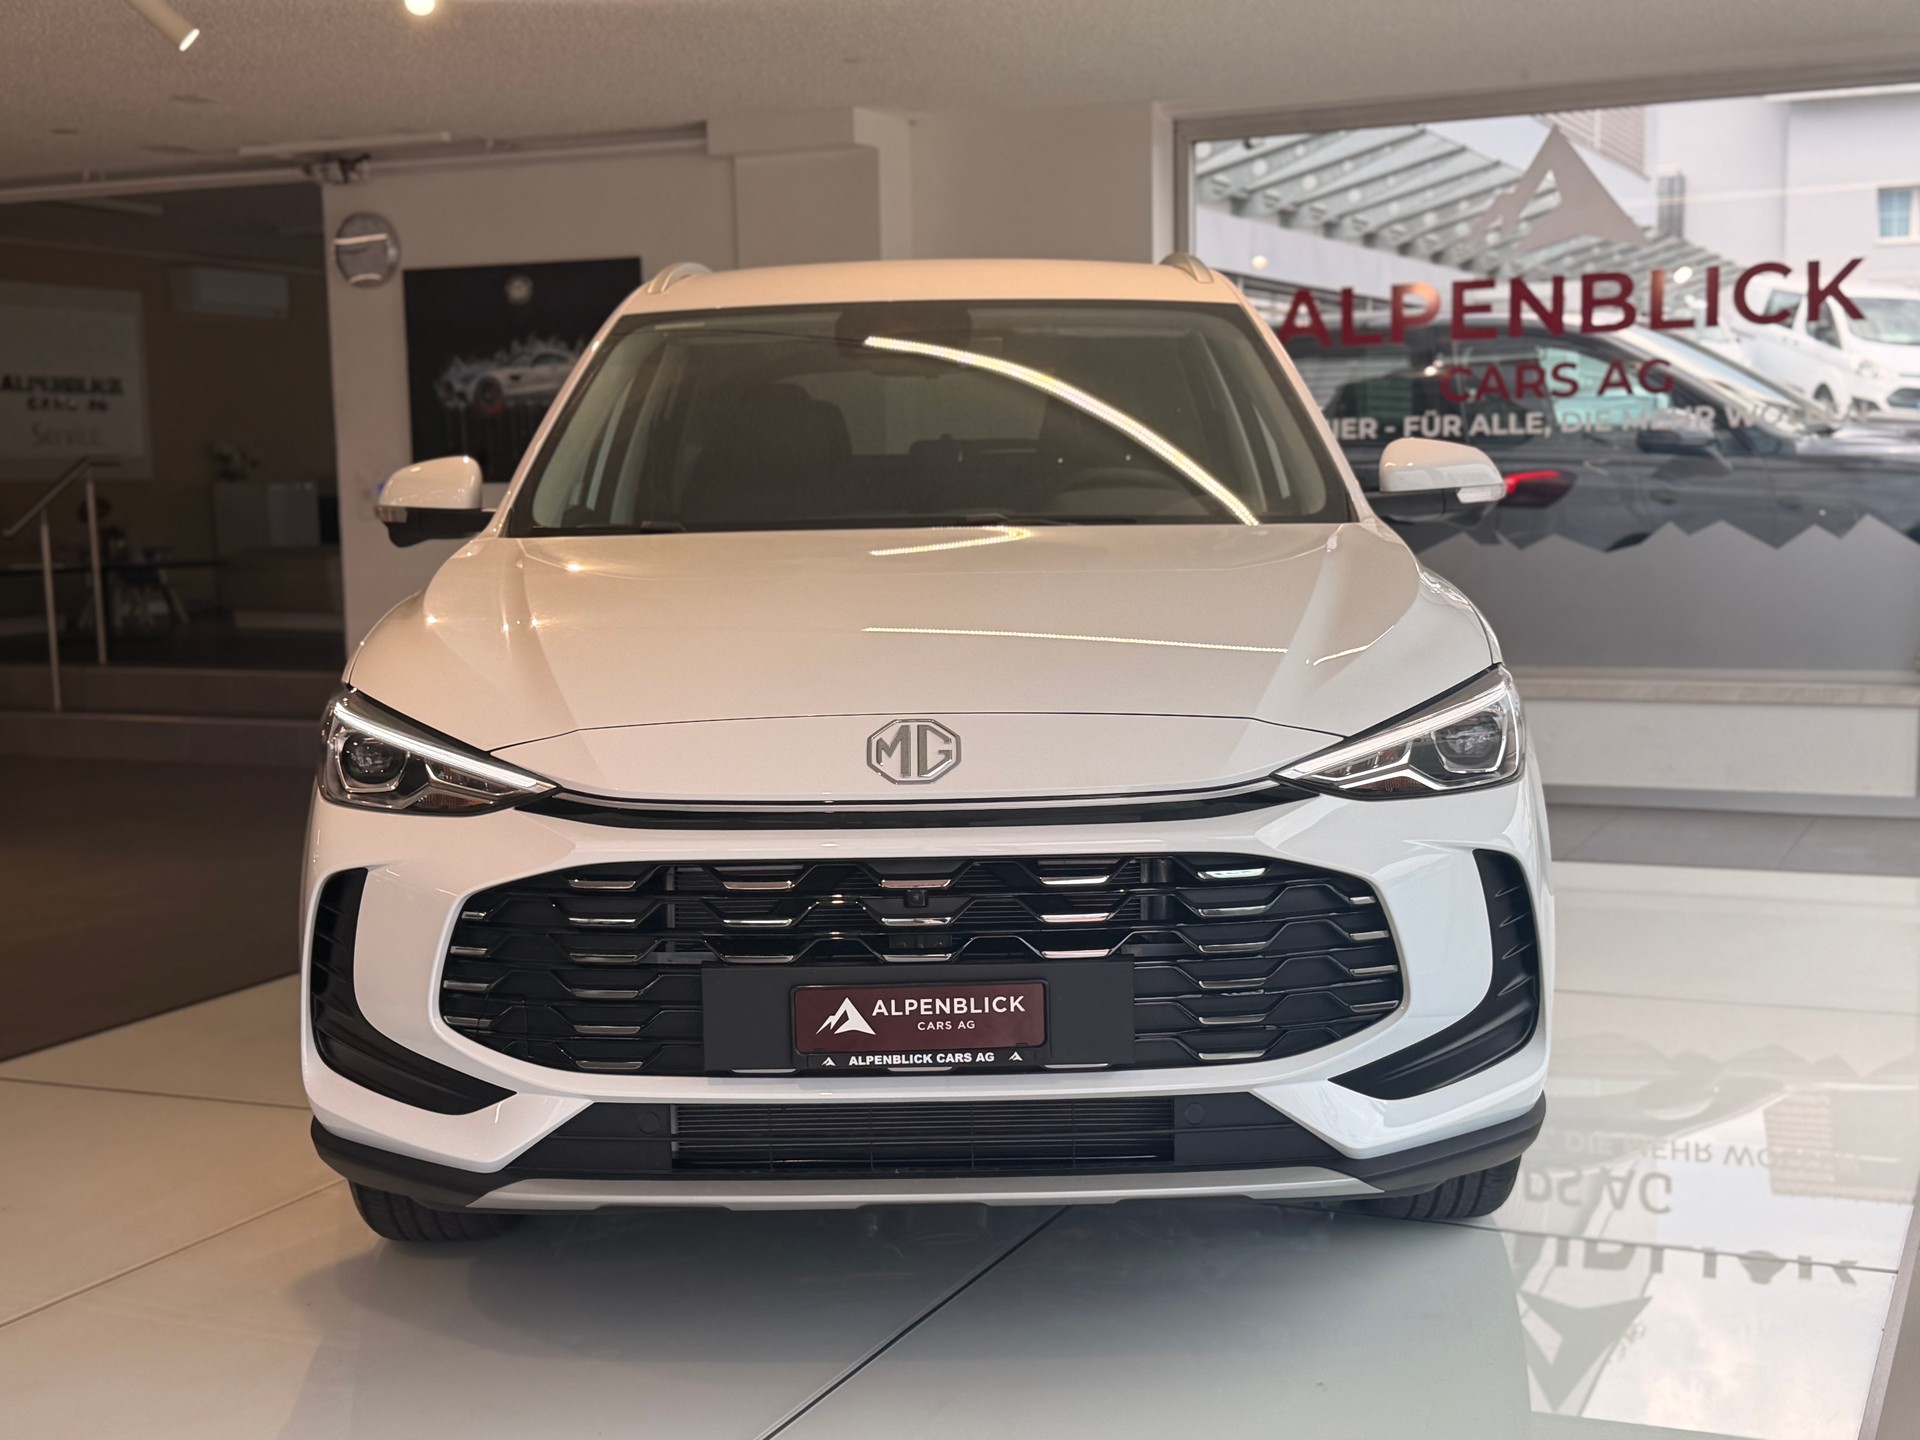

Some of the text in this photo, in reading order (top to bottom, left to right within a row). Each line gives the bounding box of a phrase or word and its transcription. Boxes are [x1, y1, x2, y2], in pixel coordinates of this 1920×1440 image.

[1277, 257, 1867, 347] ALPENBLICK
[1440, 358, 1674, 404] CARS AG
[1403, 410, 1463, 437] FÜR
[1469, 411, 1552, 438] ALLE,
[1560, 410, 1612, 433] DIE
[875, 724, 953, 778] MG
[871, 995, 1026, 1017] ALPENBLICK
[917, 1020, 976, 1031] CARS AG
[849, 1052, 995, 1066] ALPENBLICK CARS AG
